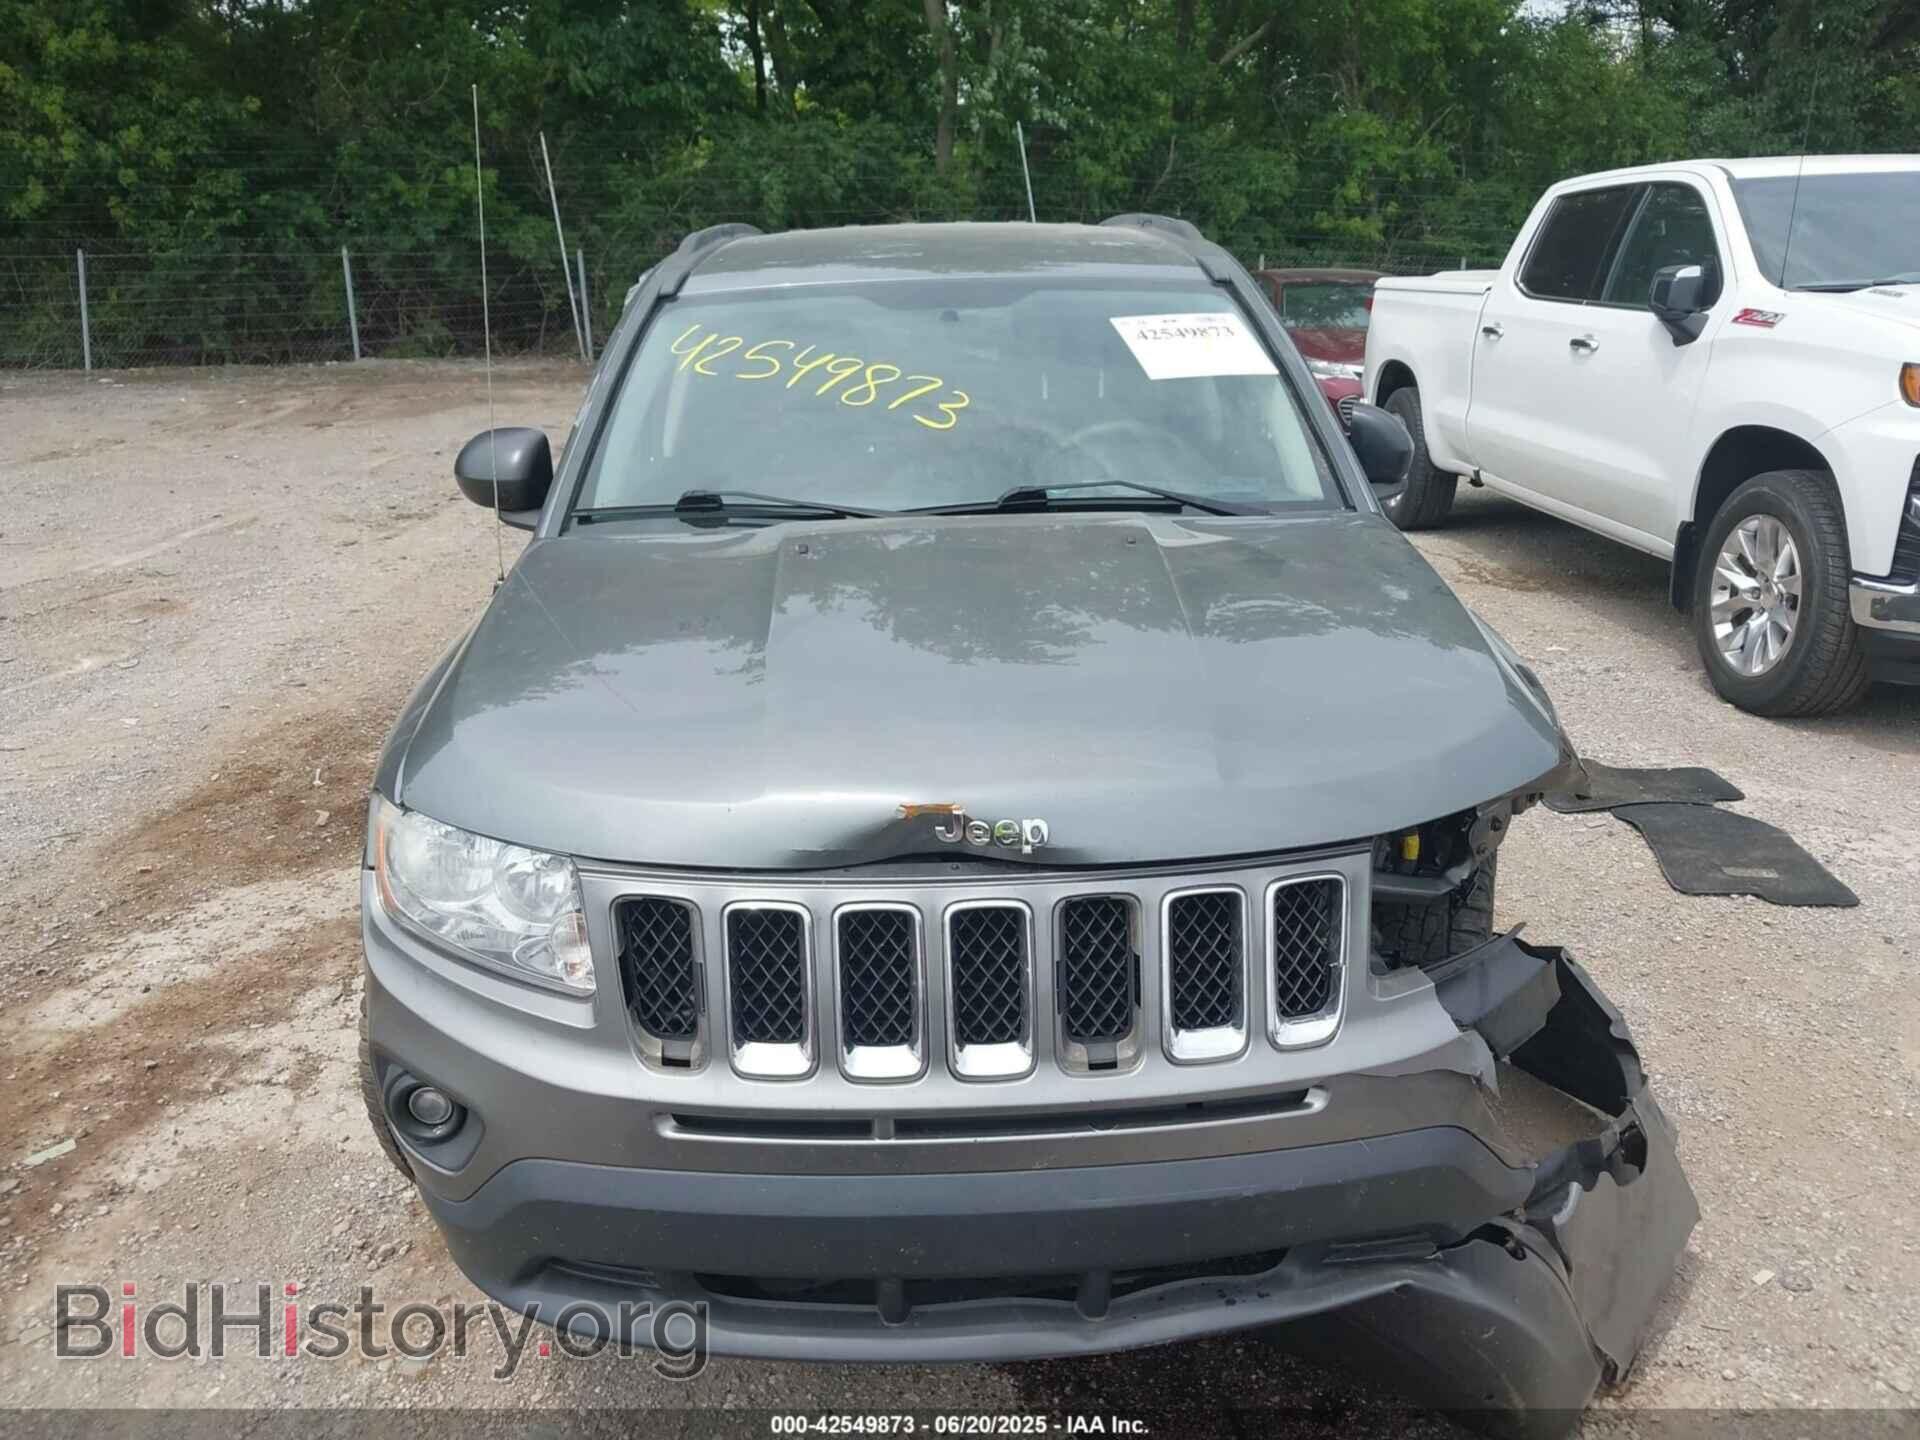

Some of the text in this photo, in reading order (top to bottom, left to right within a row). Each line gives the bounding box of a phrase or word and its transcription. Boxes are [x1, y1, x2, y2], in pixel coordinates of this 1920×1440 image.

[1137, 325, 1236, 342] 42549873
[671, 324, 970, 429] 42549873
[935, 808, 1049, 854] Jeep
